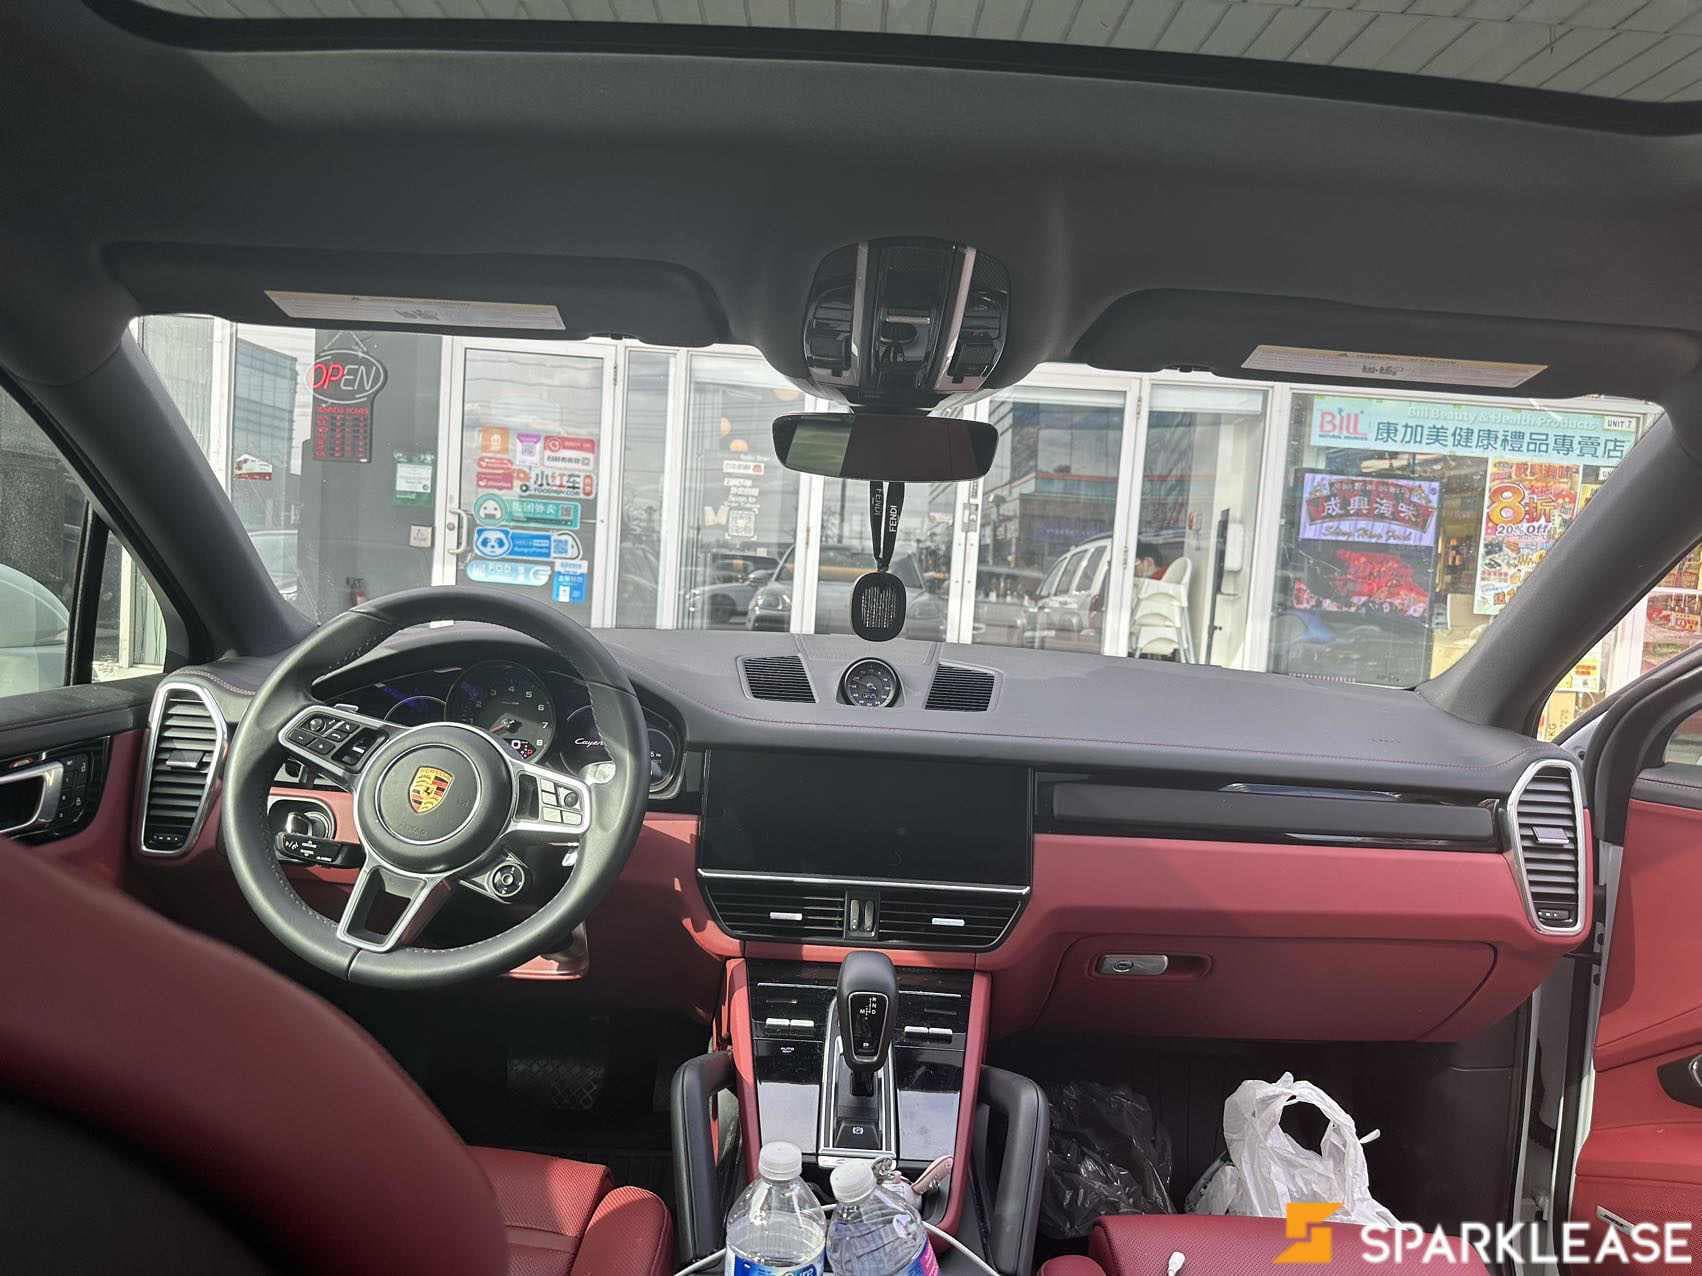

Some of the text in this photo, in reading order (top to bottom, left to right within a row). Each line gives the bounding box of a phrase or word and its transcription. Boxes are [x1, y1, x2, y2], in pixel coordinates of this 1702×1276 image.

[308, 361, 377, 391] OPEN
[1374, 421, 1626, 459] 康加美健康禮品專賣店
[889, 505, 897, 532] FENDI
[1526, 524, 1549, 534] Off
